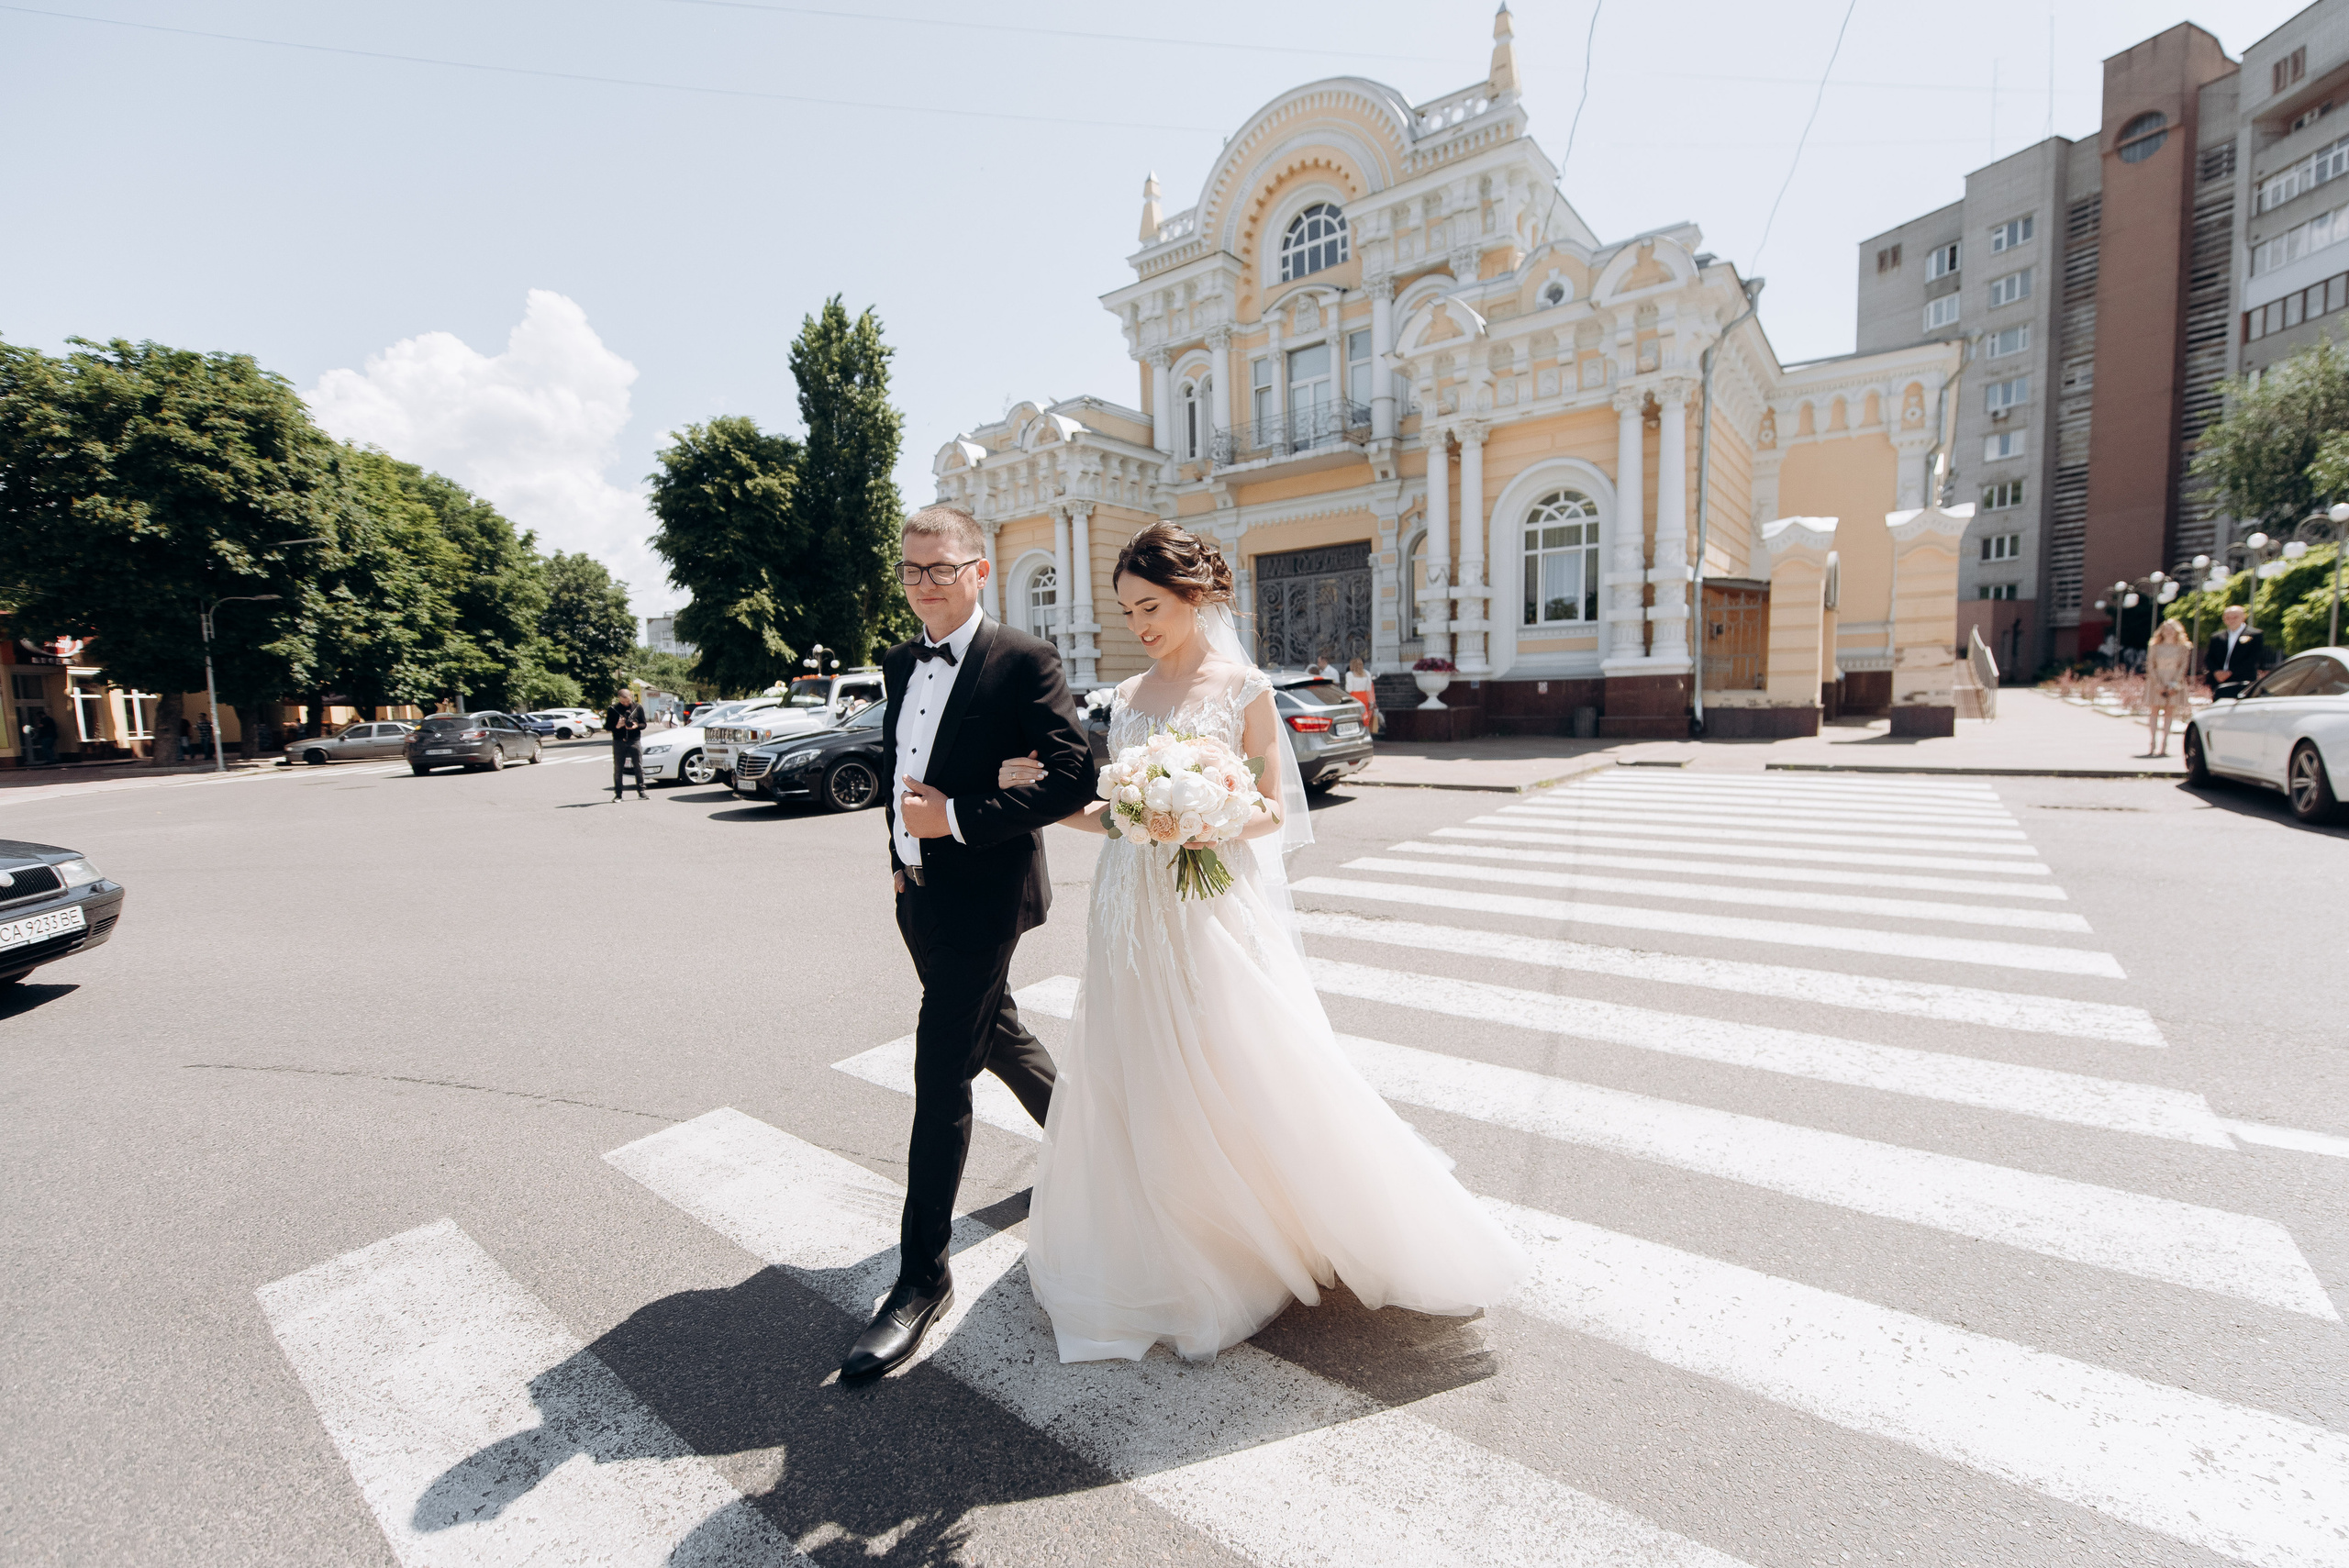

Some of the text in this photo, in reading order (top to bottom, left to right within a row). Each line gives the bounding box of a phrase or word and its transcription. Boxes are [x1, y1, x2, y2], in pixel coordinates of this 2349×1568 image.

[0, 924, 24, 942] CA
[25, 915, 59, 937] 9233
[60, 909, 81, 927] BE
